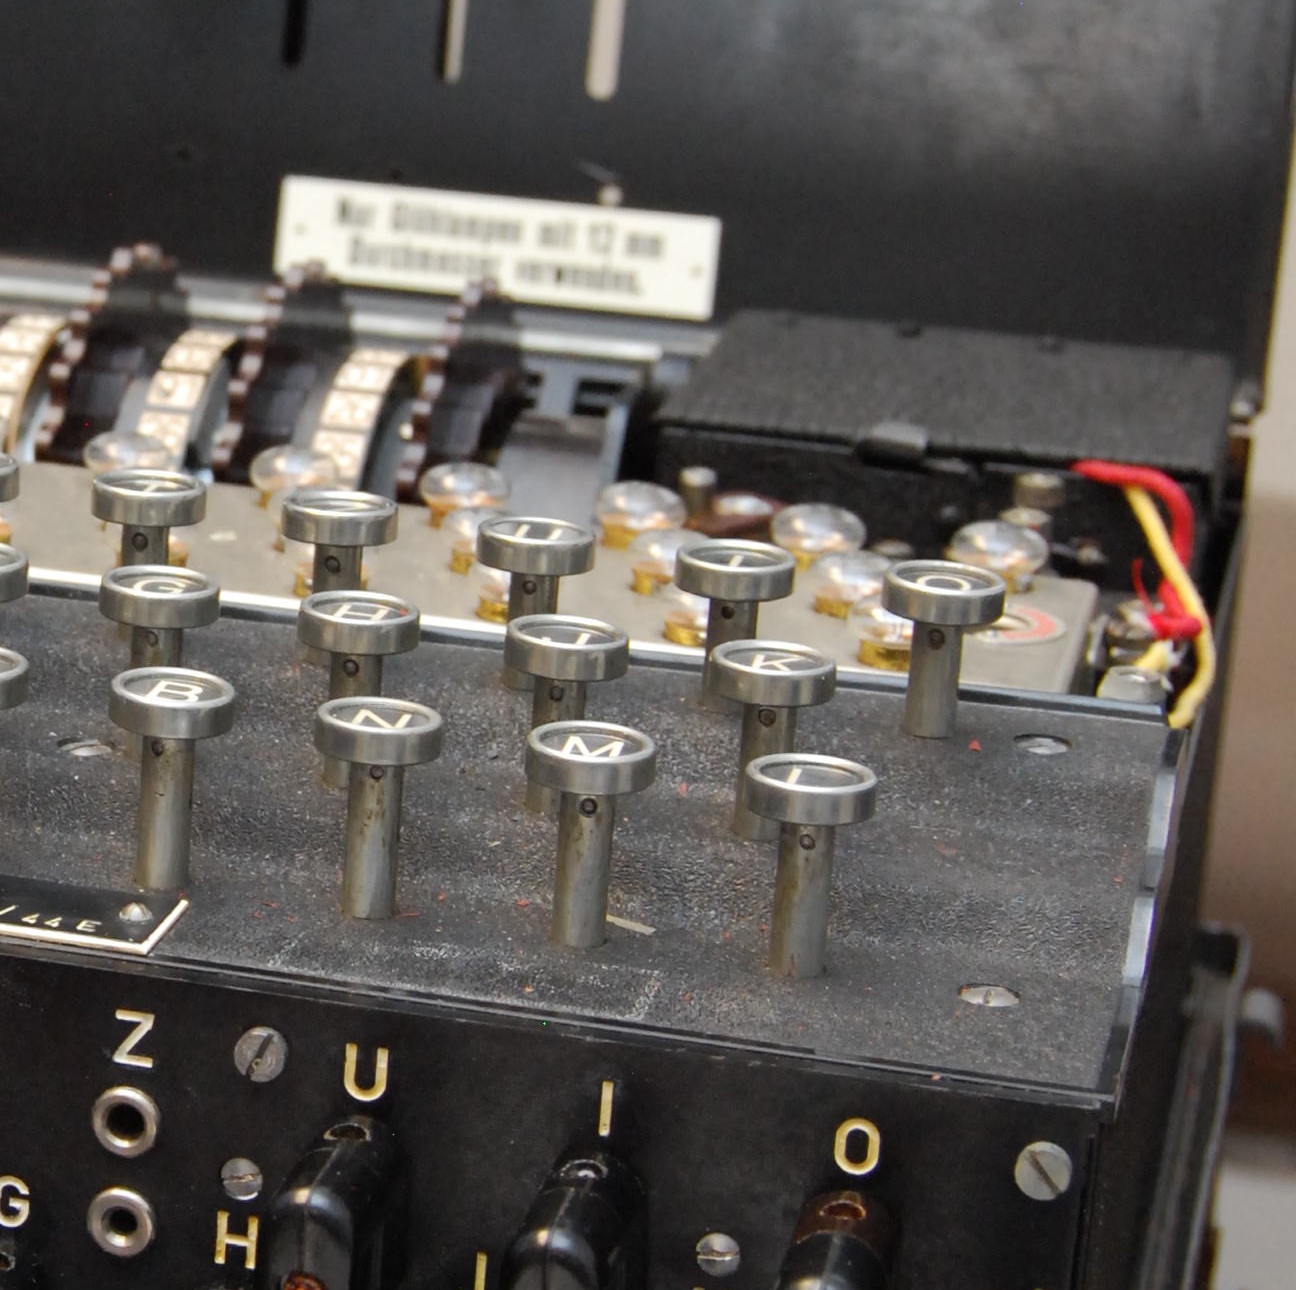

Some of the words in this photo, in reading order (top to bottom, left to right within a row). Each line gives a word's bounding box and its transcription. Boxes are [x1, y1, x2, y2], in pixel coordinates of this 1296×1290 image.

[337, 195, 375, 227] Nur
[538, 220, 575, 250] mit
[114, 1011, 154, 1068] Z
[344, 1044, 389, 1102] U
[599, 1081, 613, 1136] I
[835, 1118, 881, 1176] O
[215, 1211, 259, 1269] H
